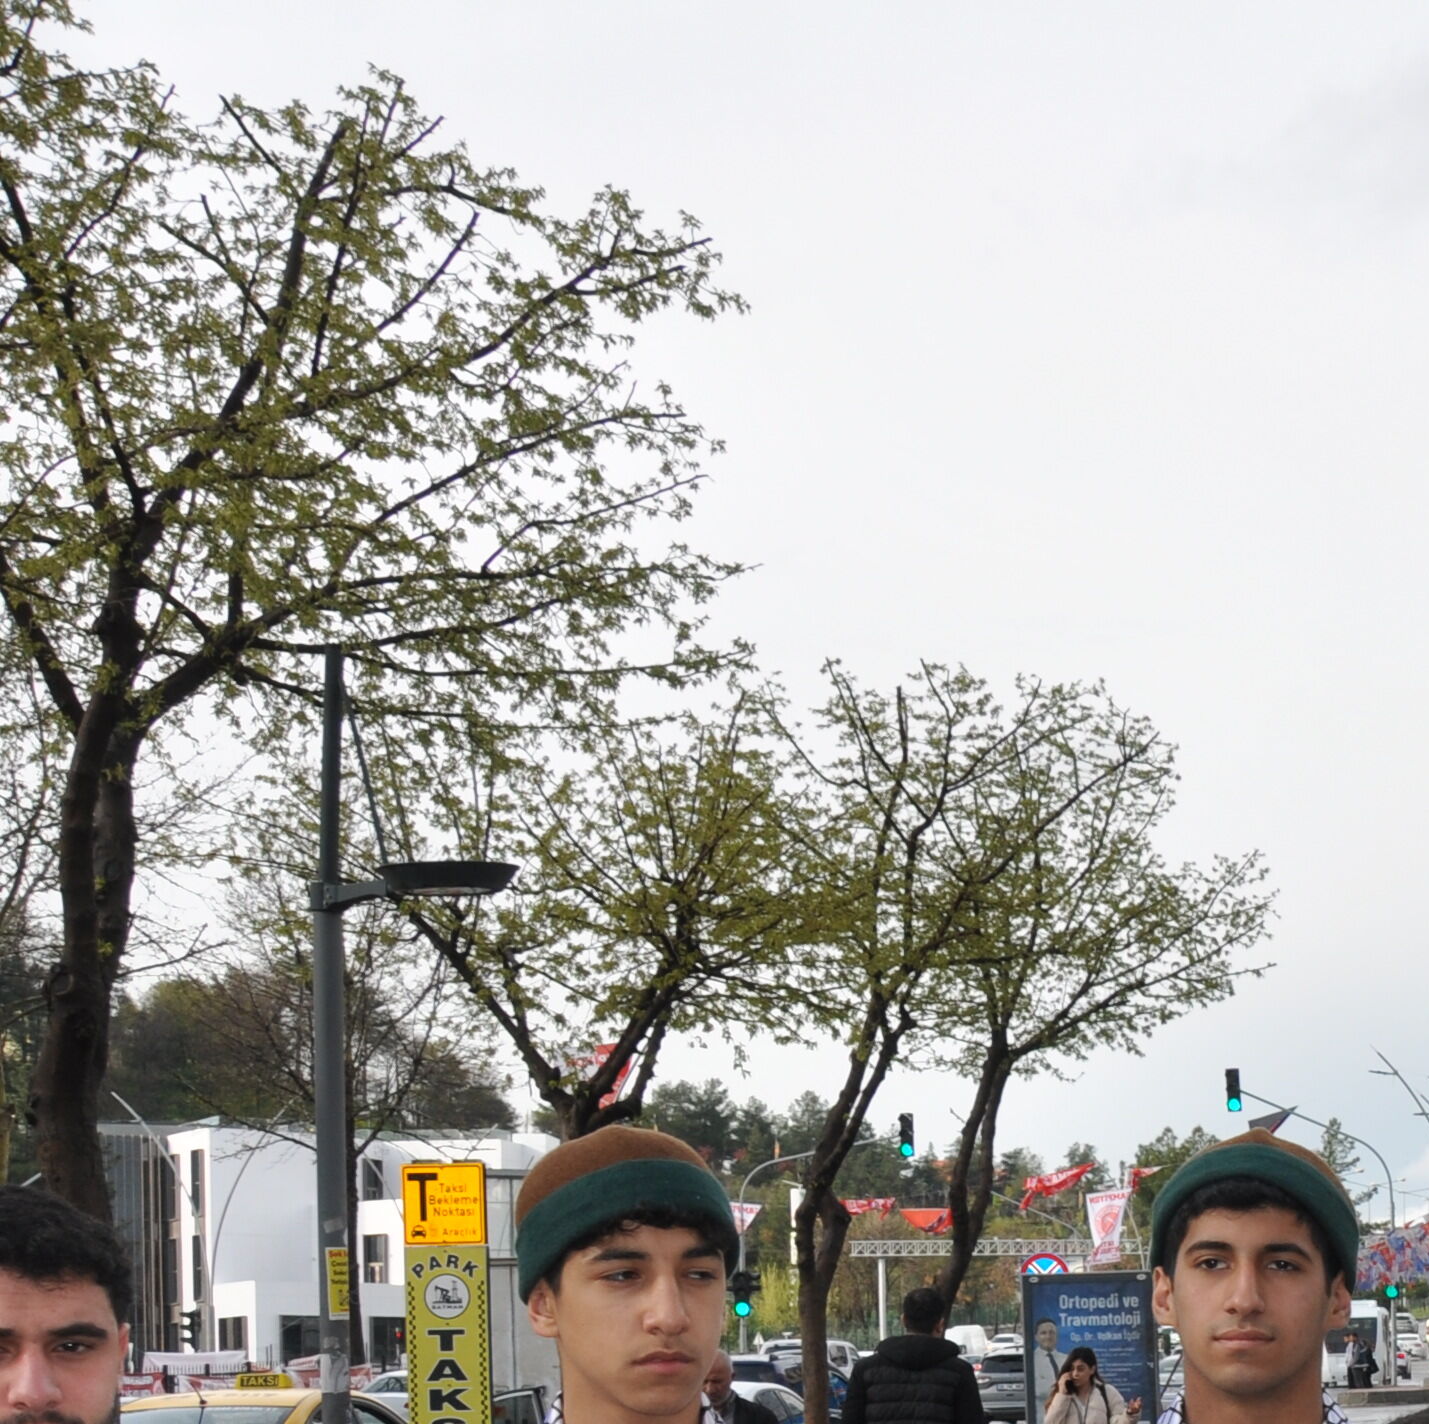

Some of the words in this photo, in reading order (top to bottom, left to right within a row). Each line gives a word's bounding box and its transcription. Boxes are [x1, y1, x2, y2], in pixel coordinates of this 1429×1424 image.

[438, 1183, 467, 1193] Taksi
[407, 1172, 438, 1222] T
[428, 1195, 479, 1205] Bekleme
[433, 1207, 475, 1217] Noktası
[411, 1254, 479, 1279] PARK
[1058, 1293, 1119, 1312] Ortopedi
[1122, 1295, 1139, 1308] ve
[1058, 1311, 1141, 1328] Travmatoloji
